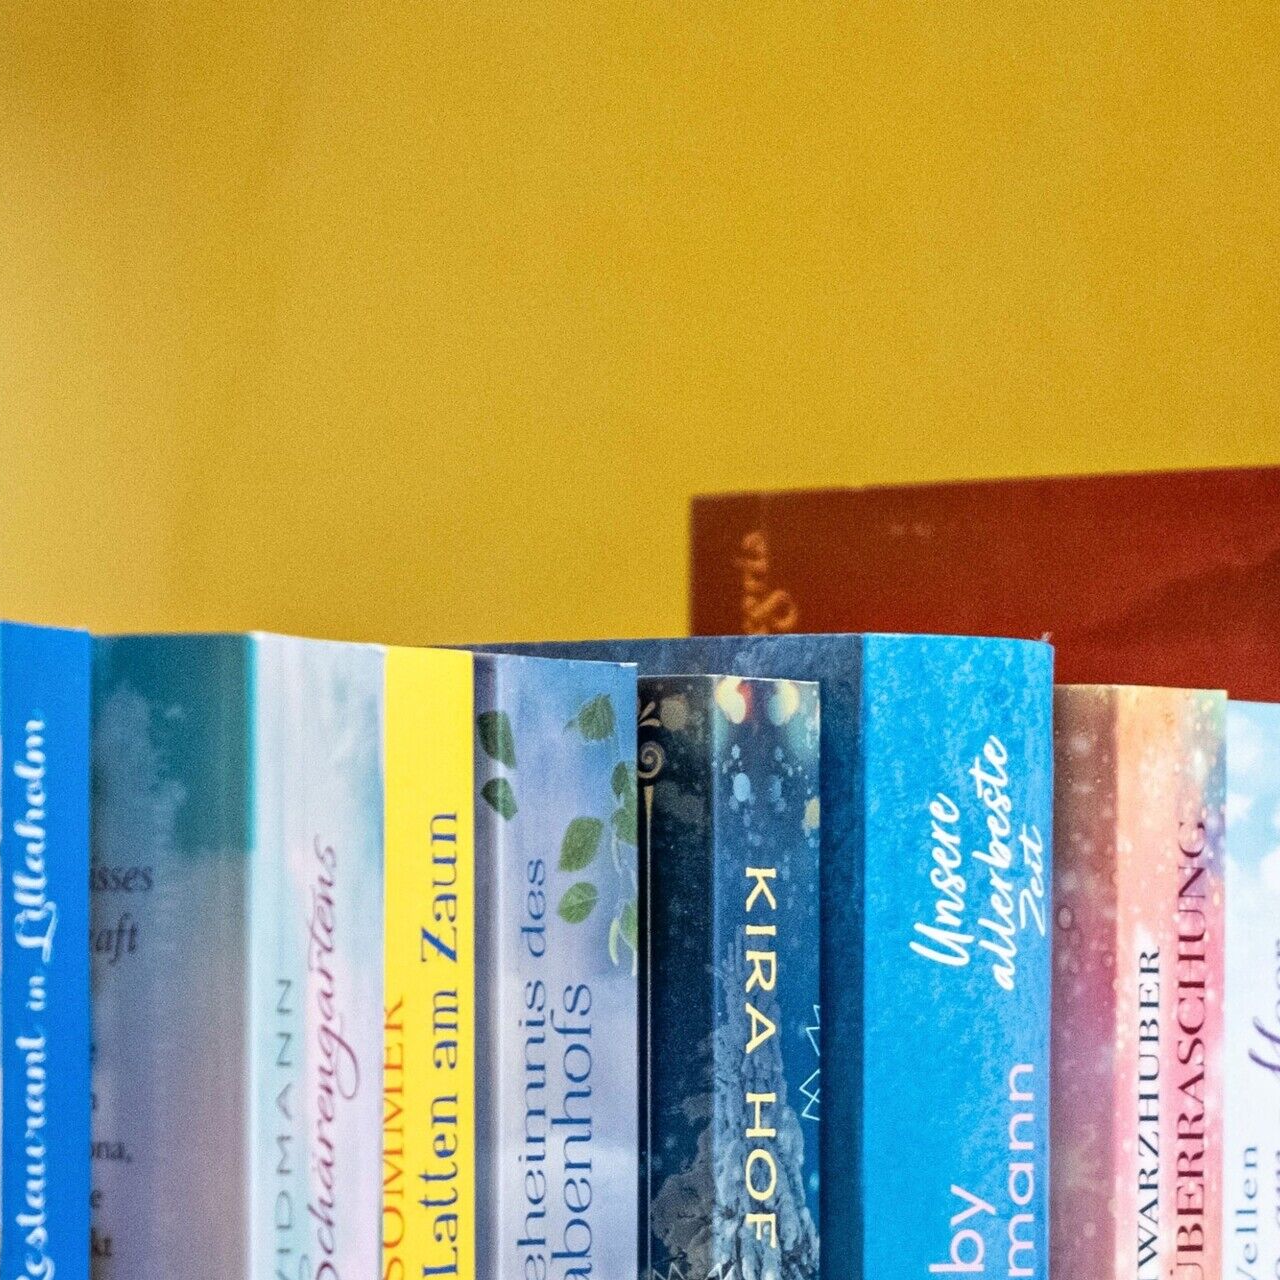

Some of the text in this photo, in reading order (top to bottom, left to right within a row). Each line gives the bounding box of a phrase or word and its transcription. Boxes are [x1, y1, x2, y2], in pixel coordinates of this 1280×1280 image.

[12, 715, 58, 965] Lillaholm
[420, 810, 459, 964] Zaun
[519, 857, 547, 959] des
[908, 790, 969, 969] Unsere
[969, 734, 1017, 993] allerbeste
[1018, 823, 1046, 937] Zeit
[27, 969, 47, 1012] in
[432, 985, 459, 1071] am
[743, 866, 779, 1250] KIRA HOF
[417, 1086, 459, 1279] Latten
